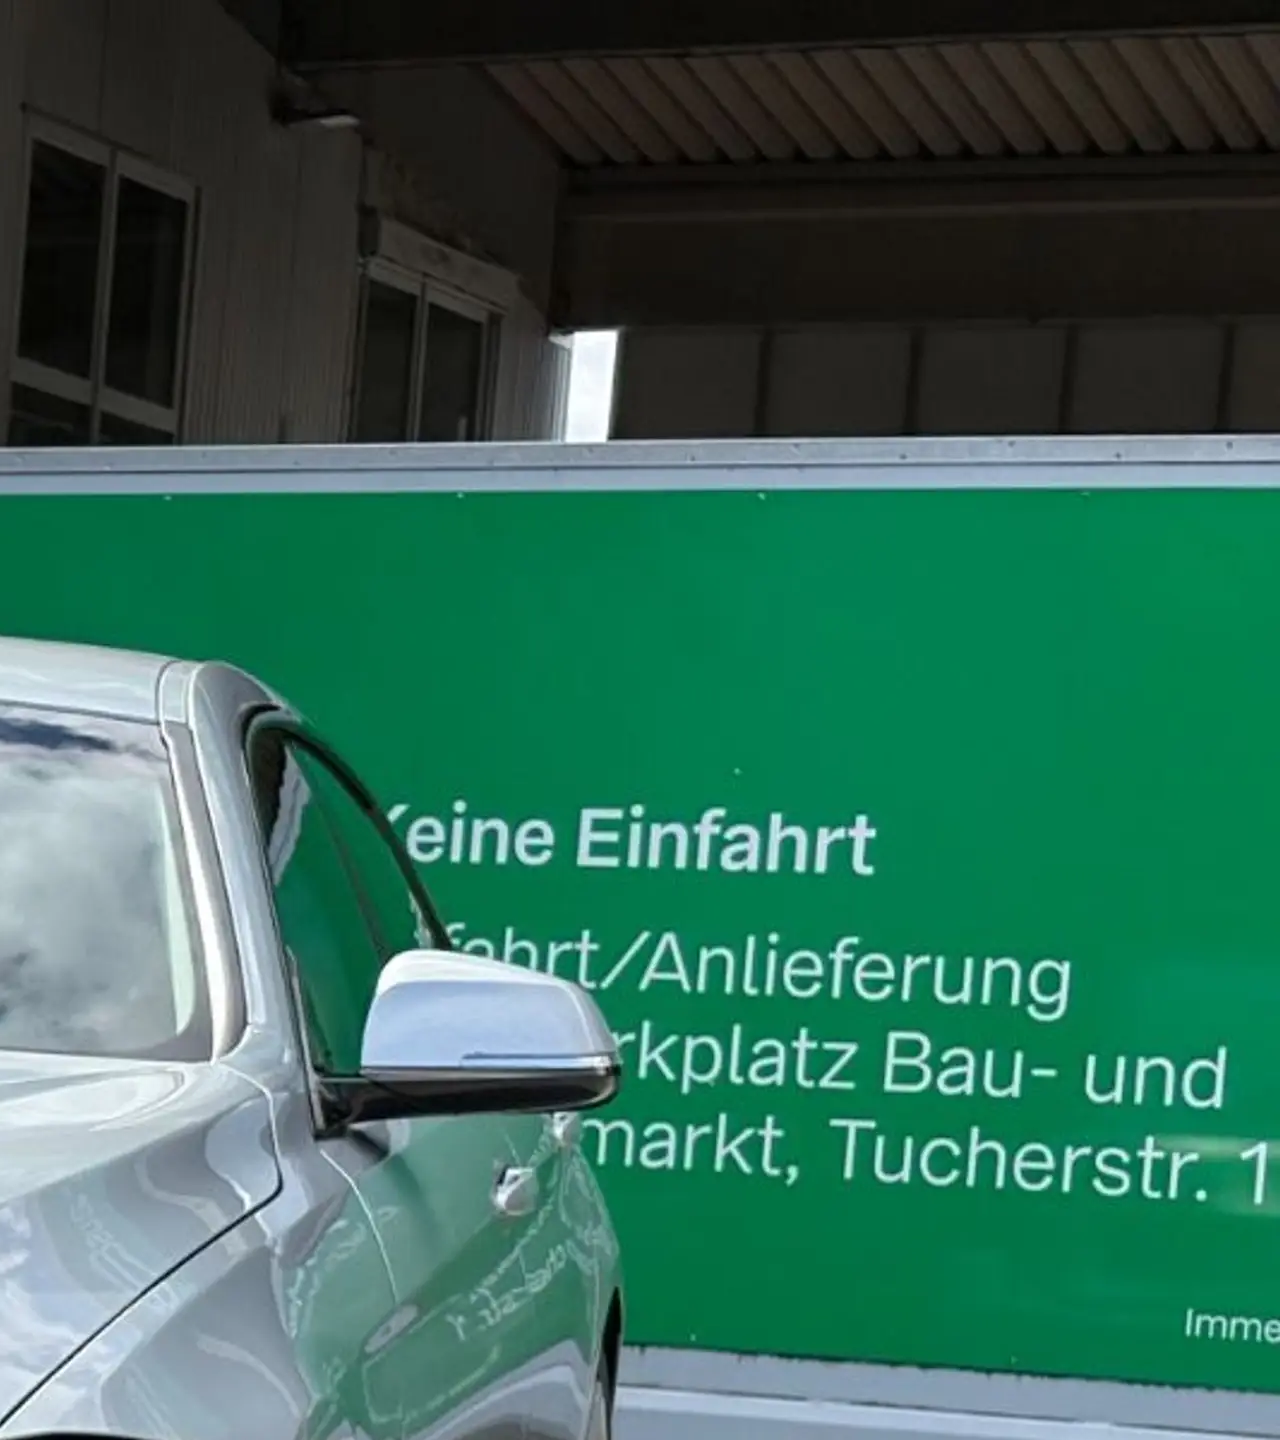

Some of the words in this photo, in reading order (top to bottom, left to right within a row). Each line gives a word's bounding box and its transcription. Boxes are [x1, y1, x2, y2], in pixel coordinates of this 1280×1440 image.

[576, 805, 877, 876] Einfahrt
[883, 1030, 1058, 1098] Bau-
[1083, 1046, 1230, 1110] und
[829, 1117, 1209, 1202] Tucherstr.
[1239, 1140, 1269, 1206] 1
[1184, 1307, 1280, 1344] Imme
